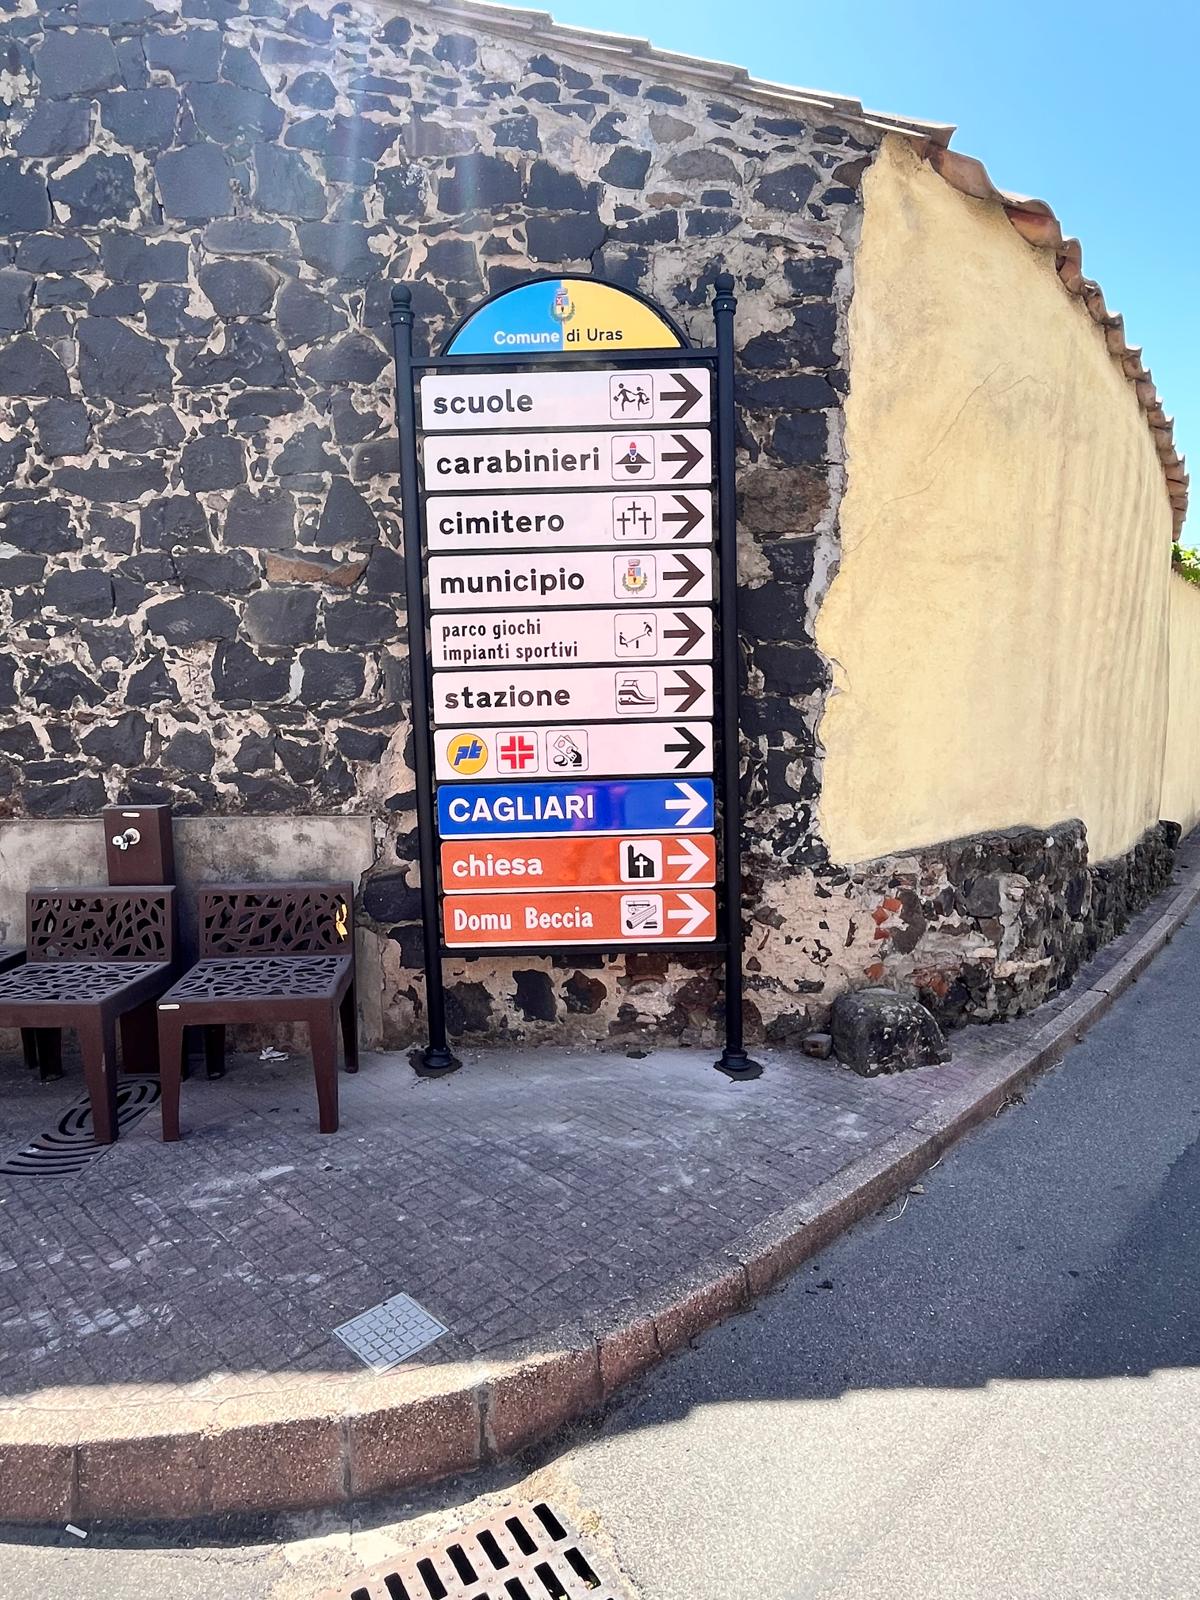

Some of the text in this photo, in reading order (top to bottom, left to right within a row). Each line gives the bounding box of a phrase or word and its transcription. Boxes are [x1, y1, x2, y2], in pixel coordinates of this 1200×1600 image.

[494, 328, 623, 345] Comune di Uras
[433, 389, 533, 414] scuole
[436, 447, 600, 475] carabinieri
[439, 510, 565, 535] cimitero
[440, 567, 585, 595] municipio
[442, 618, 541, 641] parco giochi
[443, 641, 578, 664] impianti sportivi
[445, 685, 571, 709] stazione
[448, 794, 594, 822] CAGLIARI
[452, 854, 544, 878] chiesa
[453, 906, 593, 930] Domu Beccia
